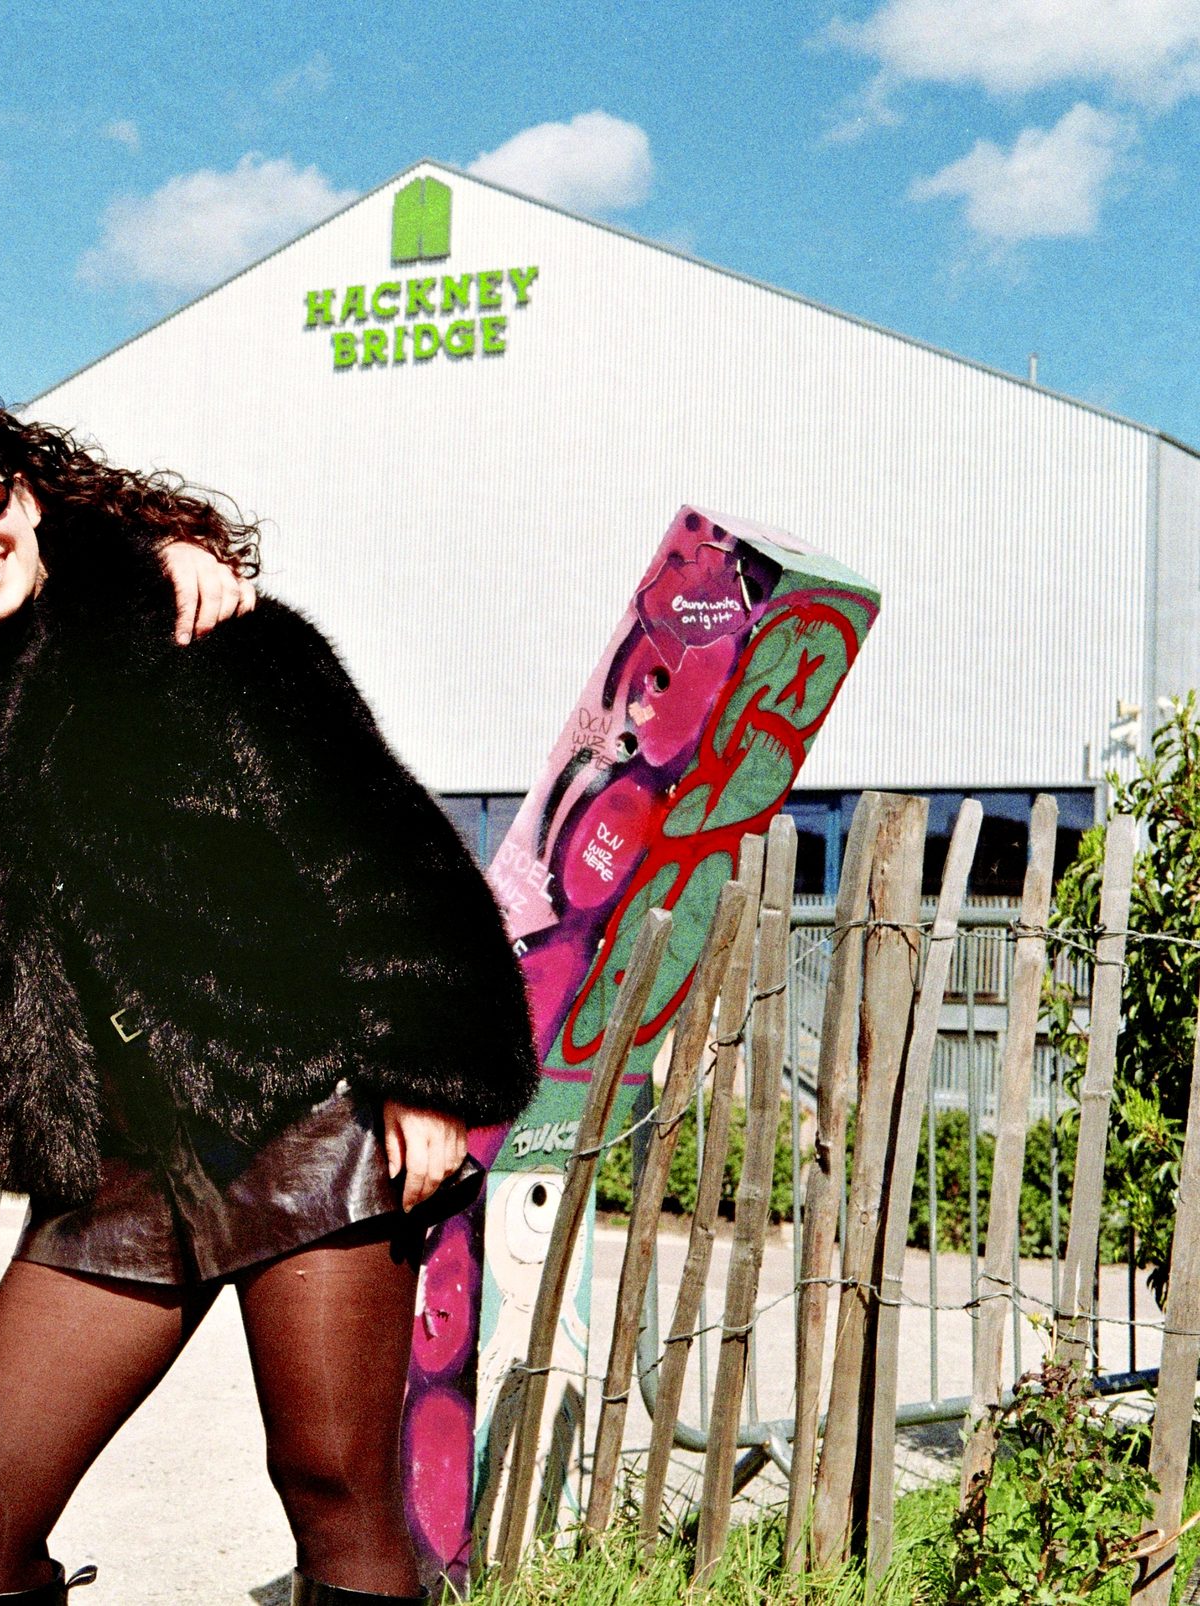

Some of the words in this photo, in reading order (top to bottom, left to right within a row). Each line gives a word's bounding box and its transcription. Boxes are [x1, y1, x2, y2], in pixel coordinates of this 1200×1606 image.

[304, 266, 539, 330] HACKNEY
[331, 315, 507, 371] BRIDGE
[681, 615, 696, 624] on
